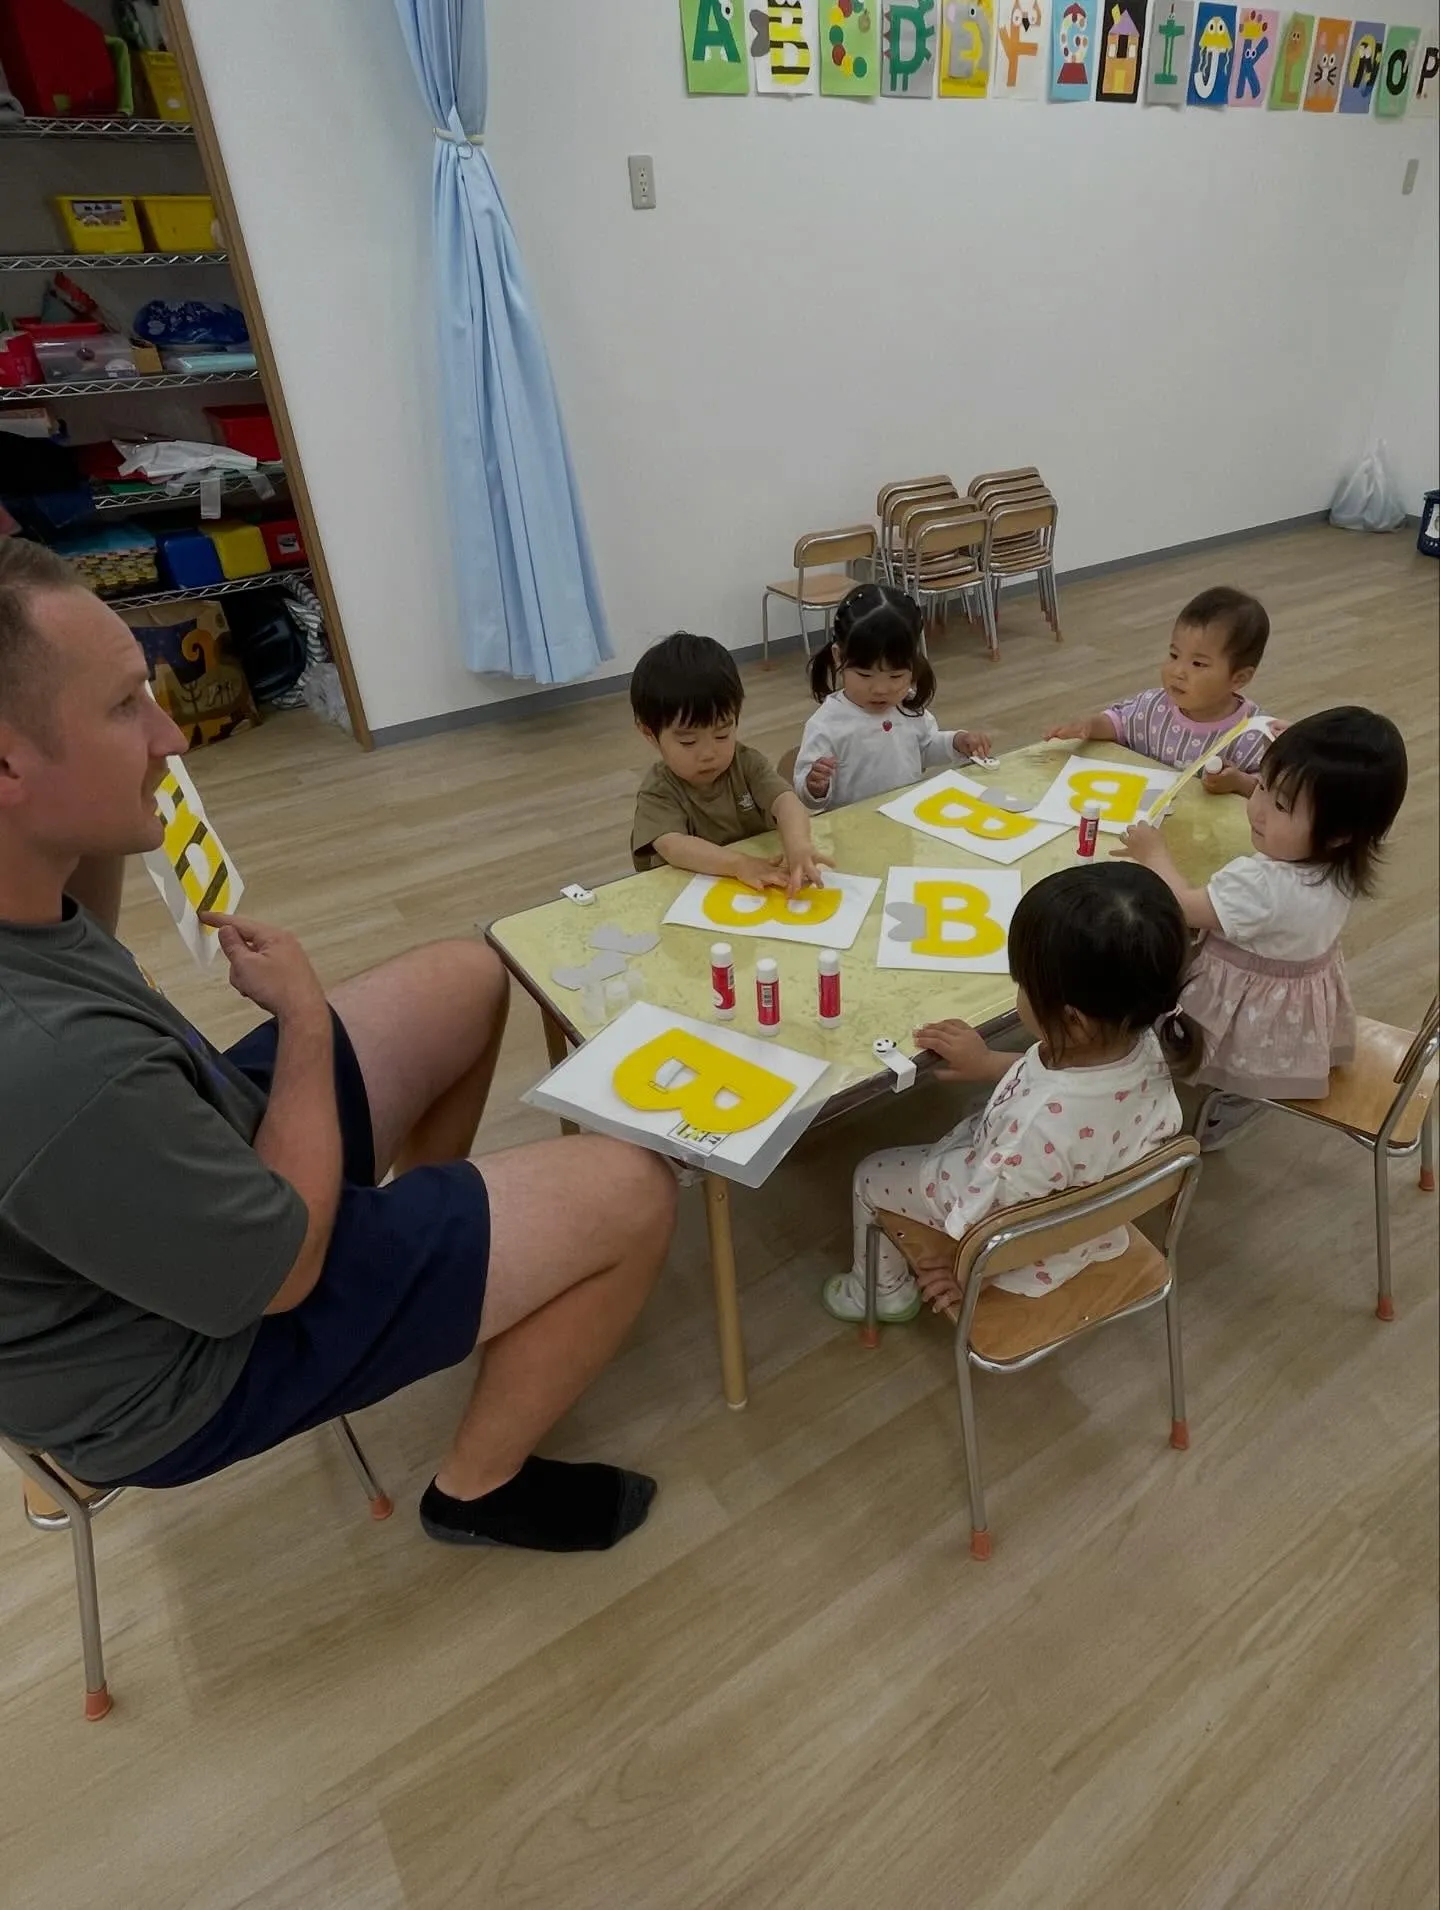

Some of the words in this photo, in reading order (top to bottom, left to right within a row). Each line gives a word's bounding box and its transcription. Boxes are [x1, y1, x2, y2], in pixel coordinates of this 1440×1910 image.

[692, 0, 741, 62] A
[768, 0, 811, 85] B
[888, 3, 929, 80] D
[1154, 20, 1184, 84] I
[1194, 30, 1228, 98] J
[1235, 36, 1269, 98] K
[1386, 49, 1408, 95] O
[1416, 47, 1439, 98] P
[914, 787, 1038, 840] B
[1068, 770, 1150, 823] B
[702, 878, 843, 926] B
[911, 881, 1006, 957] B
[612, 1027, 797, 1132] B
